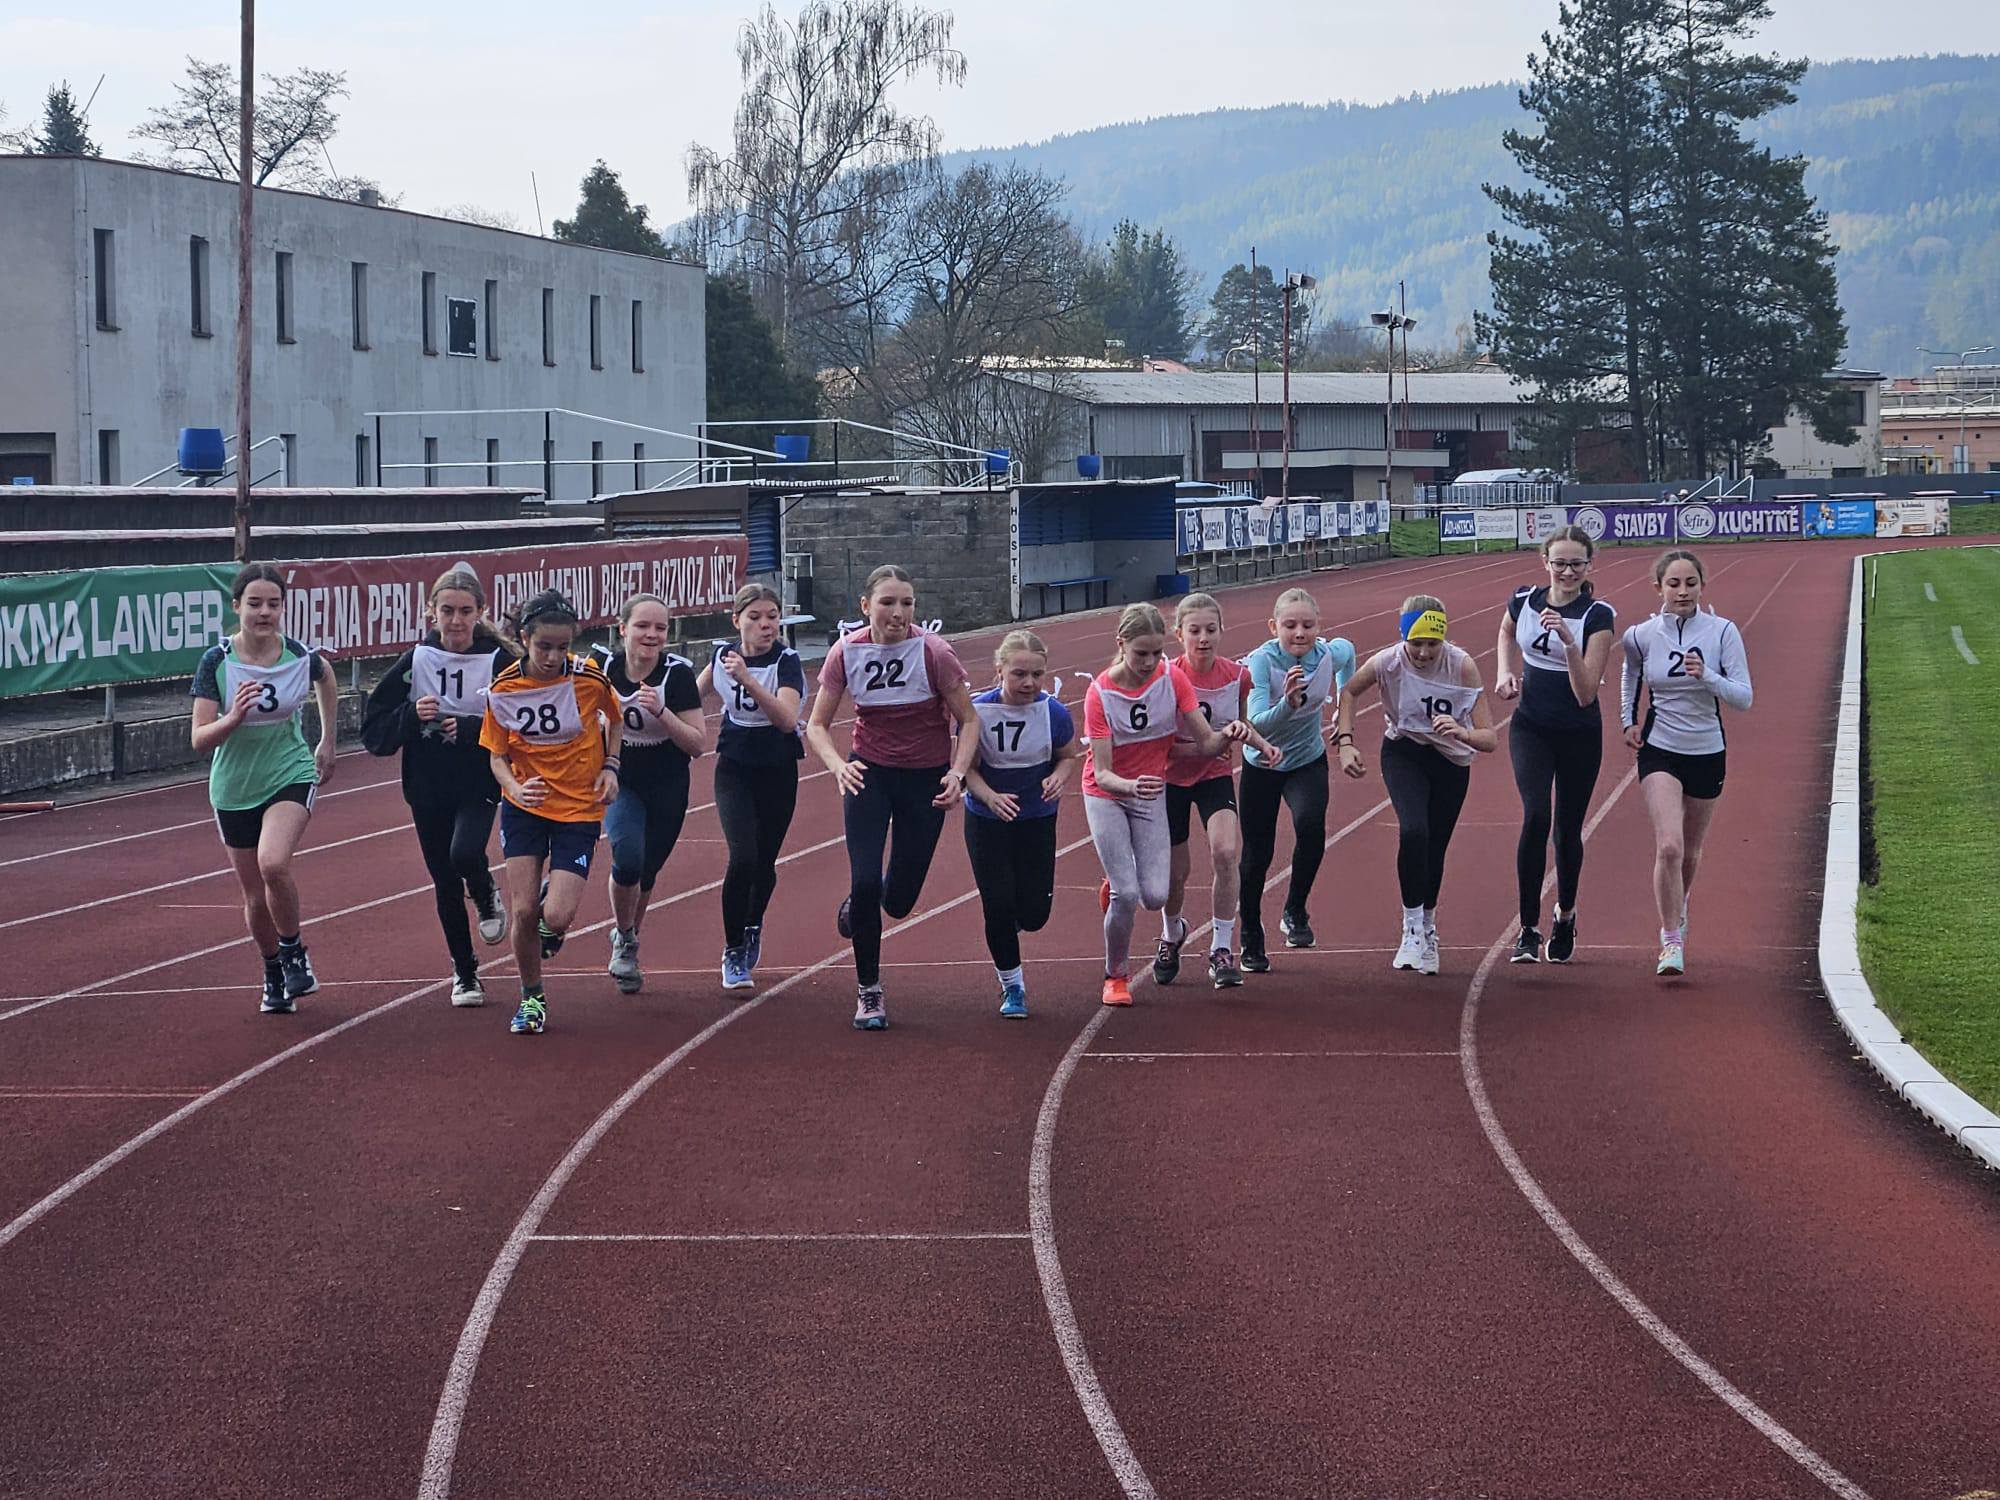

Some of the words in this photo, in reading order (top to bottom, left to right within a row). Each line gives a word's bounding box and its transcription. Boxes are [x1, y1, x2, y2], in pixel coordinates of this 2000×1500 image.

[1614, 512, 1667, 537] STAVBY
[1718, 505, 1799, 533] KUCHYNĚ
[281, 570, 361, 650] ÍDELNA
[368, 581, 427, 645] PERLA
[600, 561, 645, 617] BUFET
[652, 556, 705, 609] ROZVOZ
[0, 601, 86, 669] KNA
[90, 590, 224, 659] LANGER
[1531, 630, 1551, 656] 4
[436, 668, 464, 700] 11
[864, 659, 906, 692] 22
[257, 683, 280, 714] 3
[731, 683, 759, 712] 15
[516, 703, 561, 736] 28
[1129, 704, 1149, 731] 6
[991, 721, 1026, 752] 17
